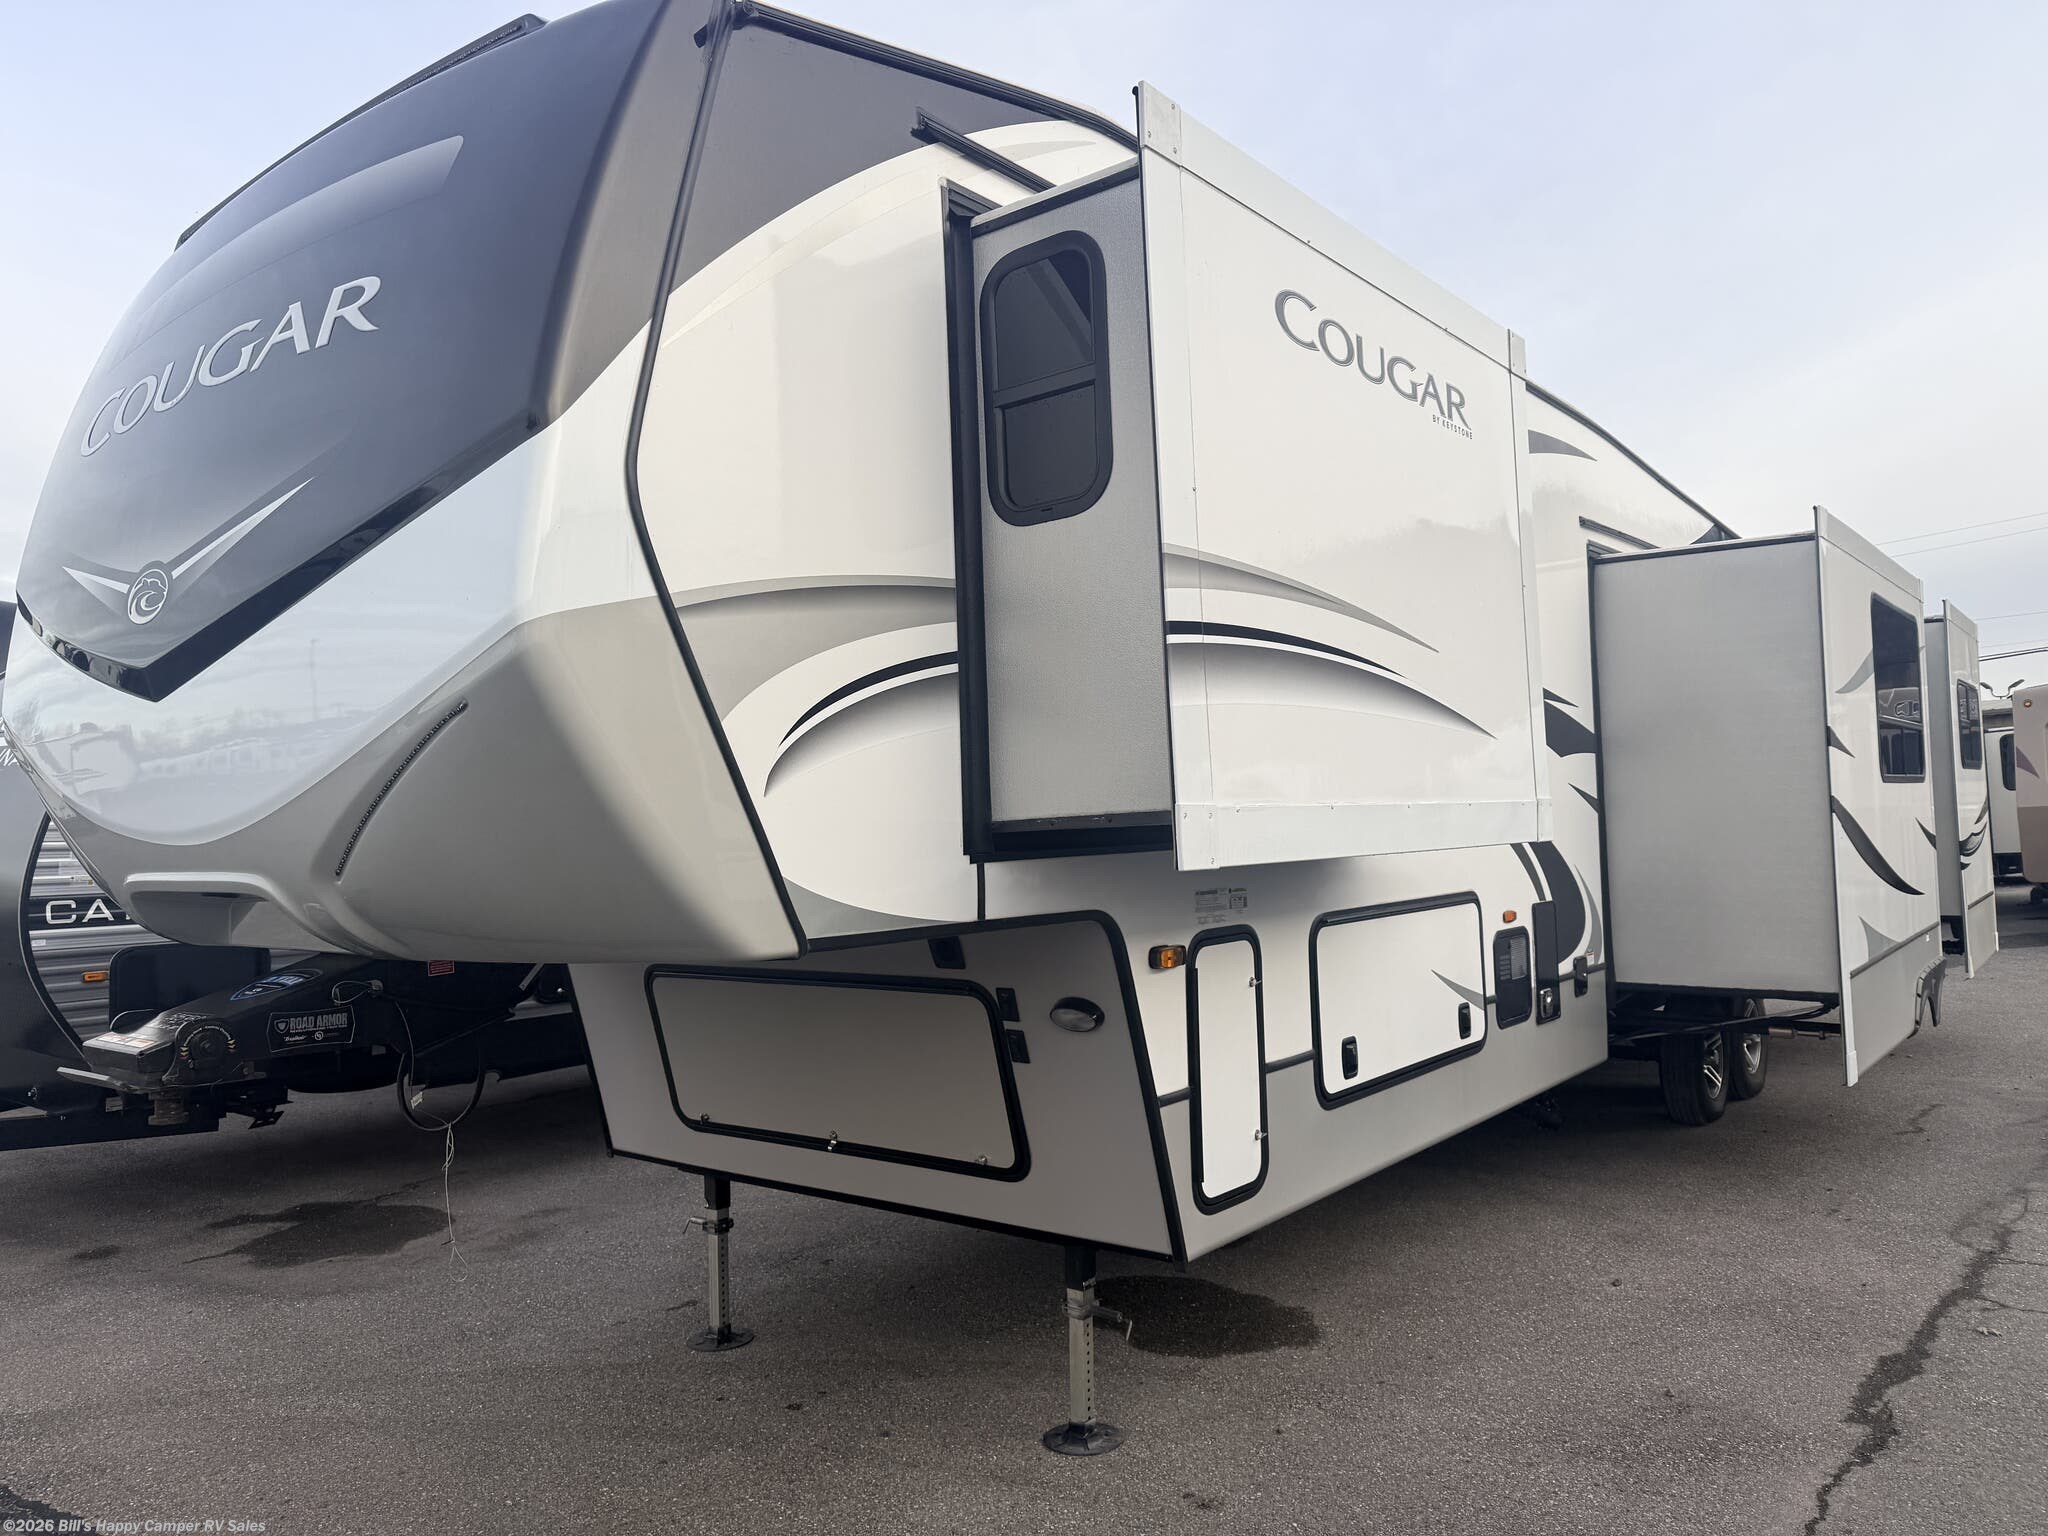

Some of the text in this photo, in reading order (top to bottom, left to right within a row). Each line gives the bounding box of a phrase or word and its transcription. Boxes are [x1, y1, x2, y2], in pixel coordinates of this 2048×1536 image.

[80, 275, 382, 457] COUGAR
[1274, 288, 1473, 431] COUGAR
[1441, 419, 1473, 440] KEYSTONE
[45, 898, 131, 924] CA
[289, 1016, 315, 1030] ROAD
[316, 1013, 348, 1028] ARMOR
